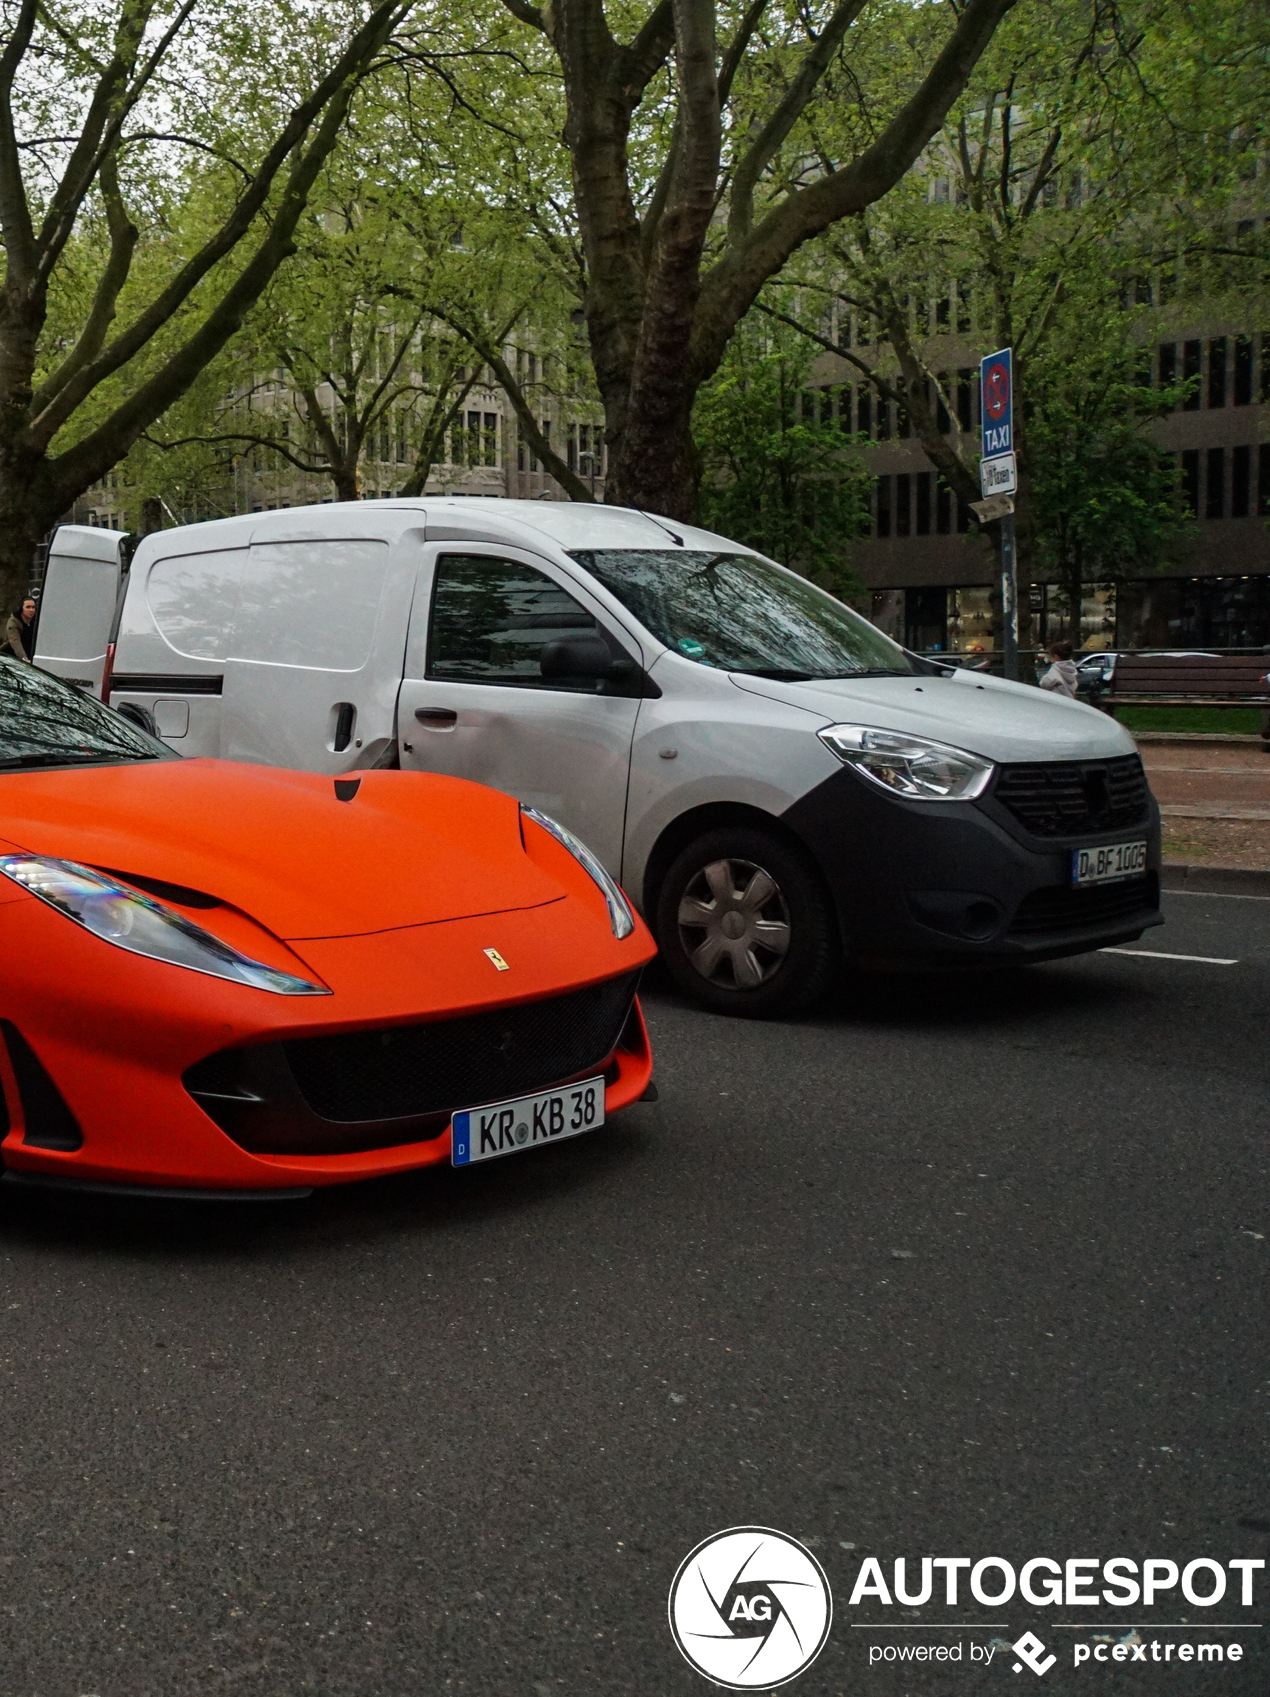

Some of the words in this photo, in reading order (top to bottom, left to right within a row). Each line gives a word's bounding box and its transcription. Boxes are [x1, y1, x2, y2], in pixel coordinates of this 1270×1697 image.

[985, 424, 1009, 452] TAXI
[1079, 852, 1089, 878] D
[1097, 848, 1114, 875] BF
[1115, 843, 1146, 872] 1005
[480, 1109, 515, 1154] KR
[532, 1097, 565, 1141] KB
[570, 1087, 596, 1130] 38
[458, 1144, 465, 1155] D
